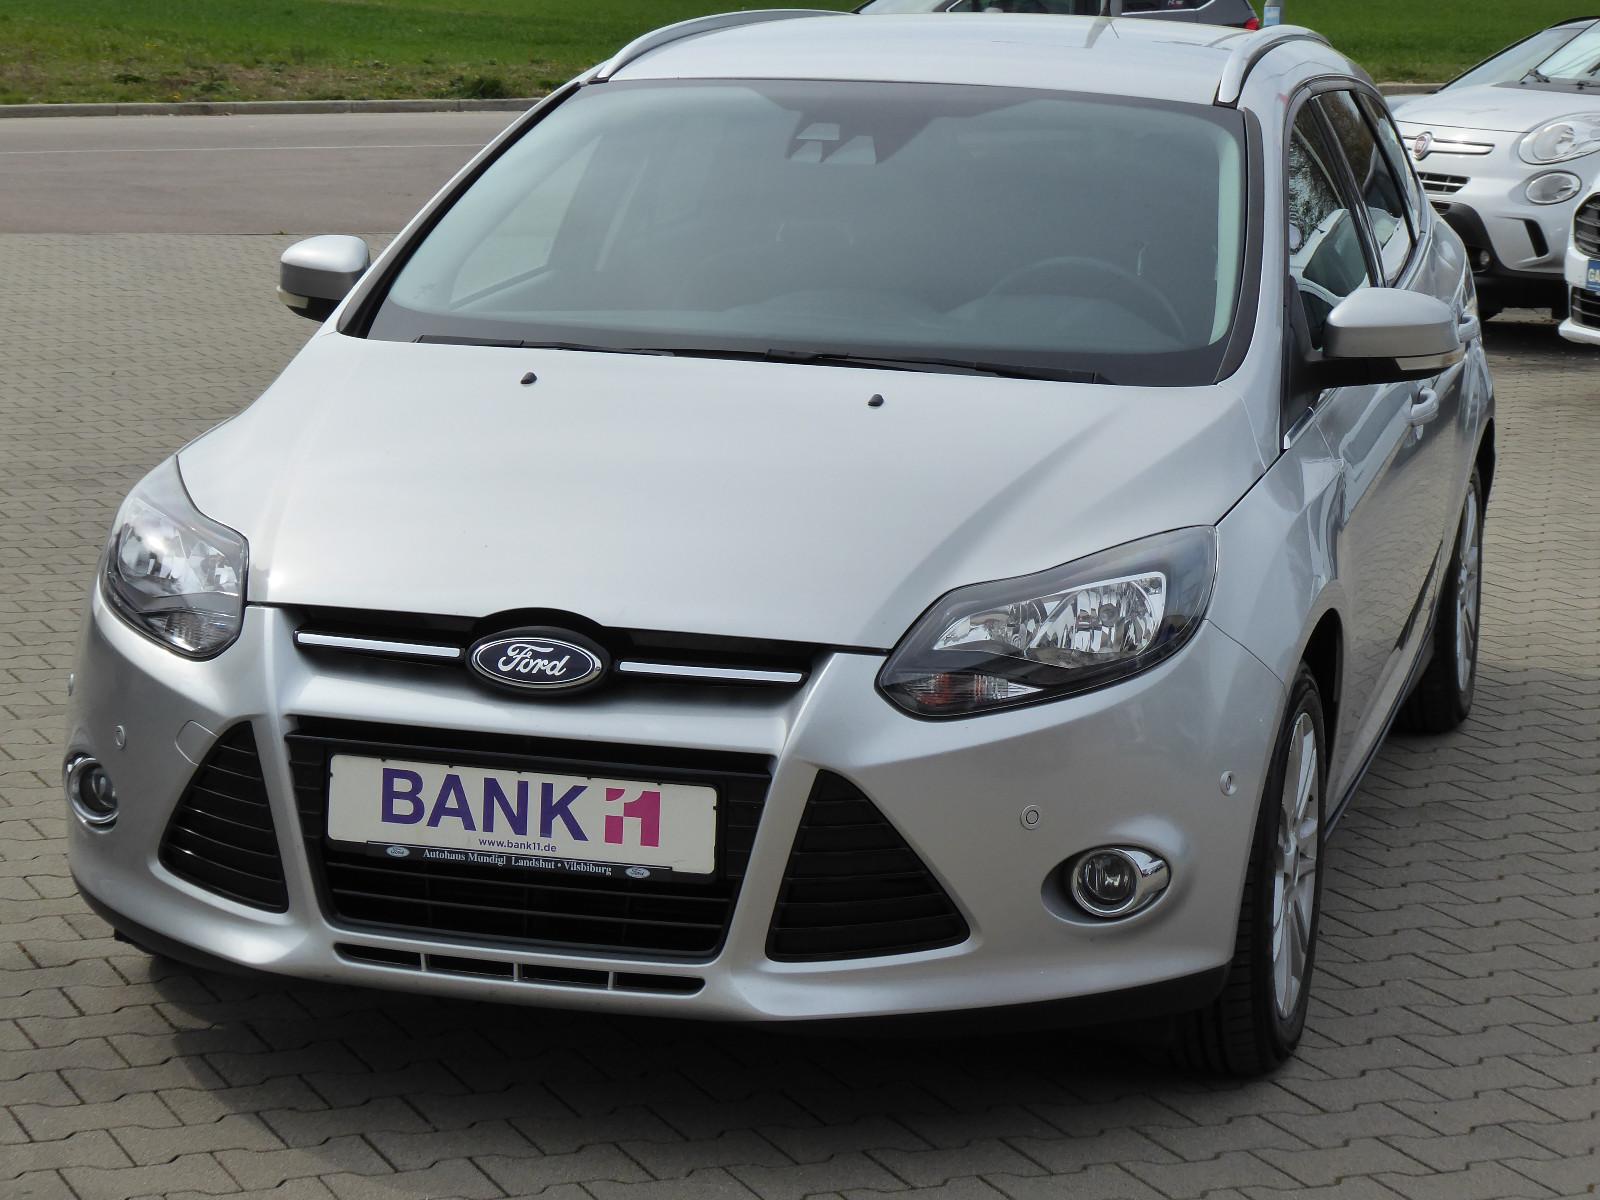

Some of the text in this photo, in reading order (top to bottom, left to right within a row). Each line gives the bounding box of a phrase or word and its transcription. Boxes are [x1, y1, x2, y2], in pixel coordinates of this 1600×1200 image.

[499, 644, 570, 676] Ford
[381, 768, 588, 842] BANK
[478, 838, 557, 853] www.bank11.de
[422, 849, 466, 861] Autohaus
[511, 856, 555, 869] Landshut
[563, 862, 612, 876] Vilsbiburg
